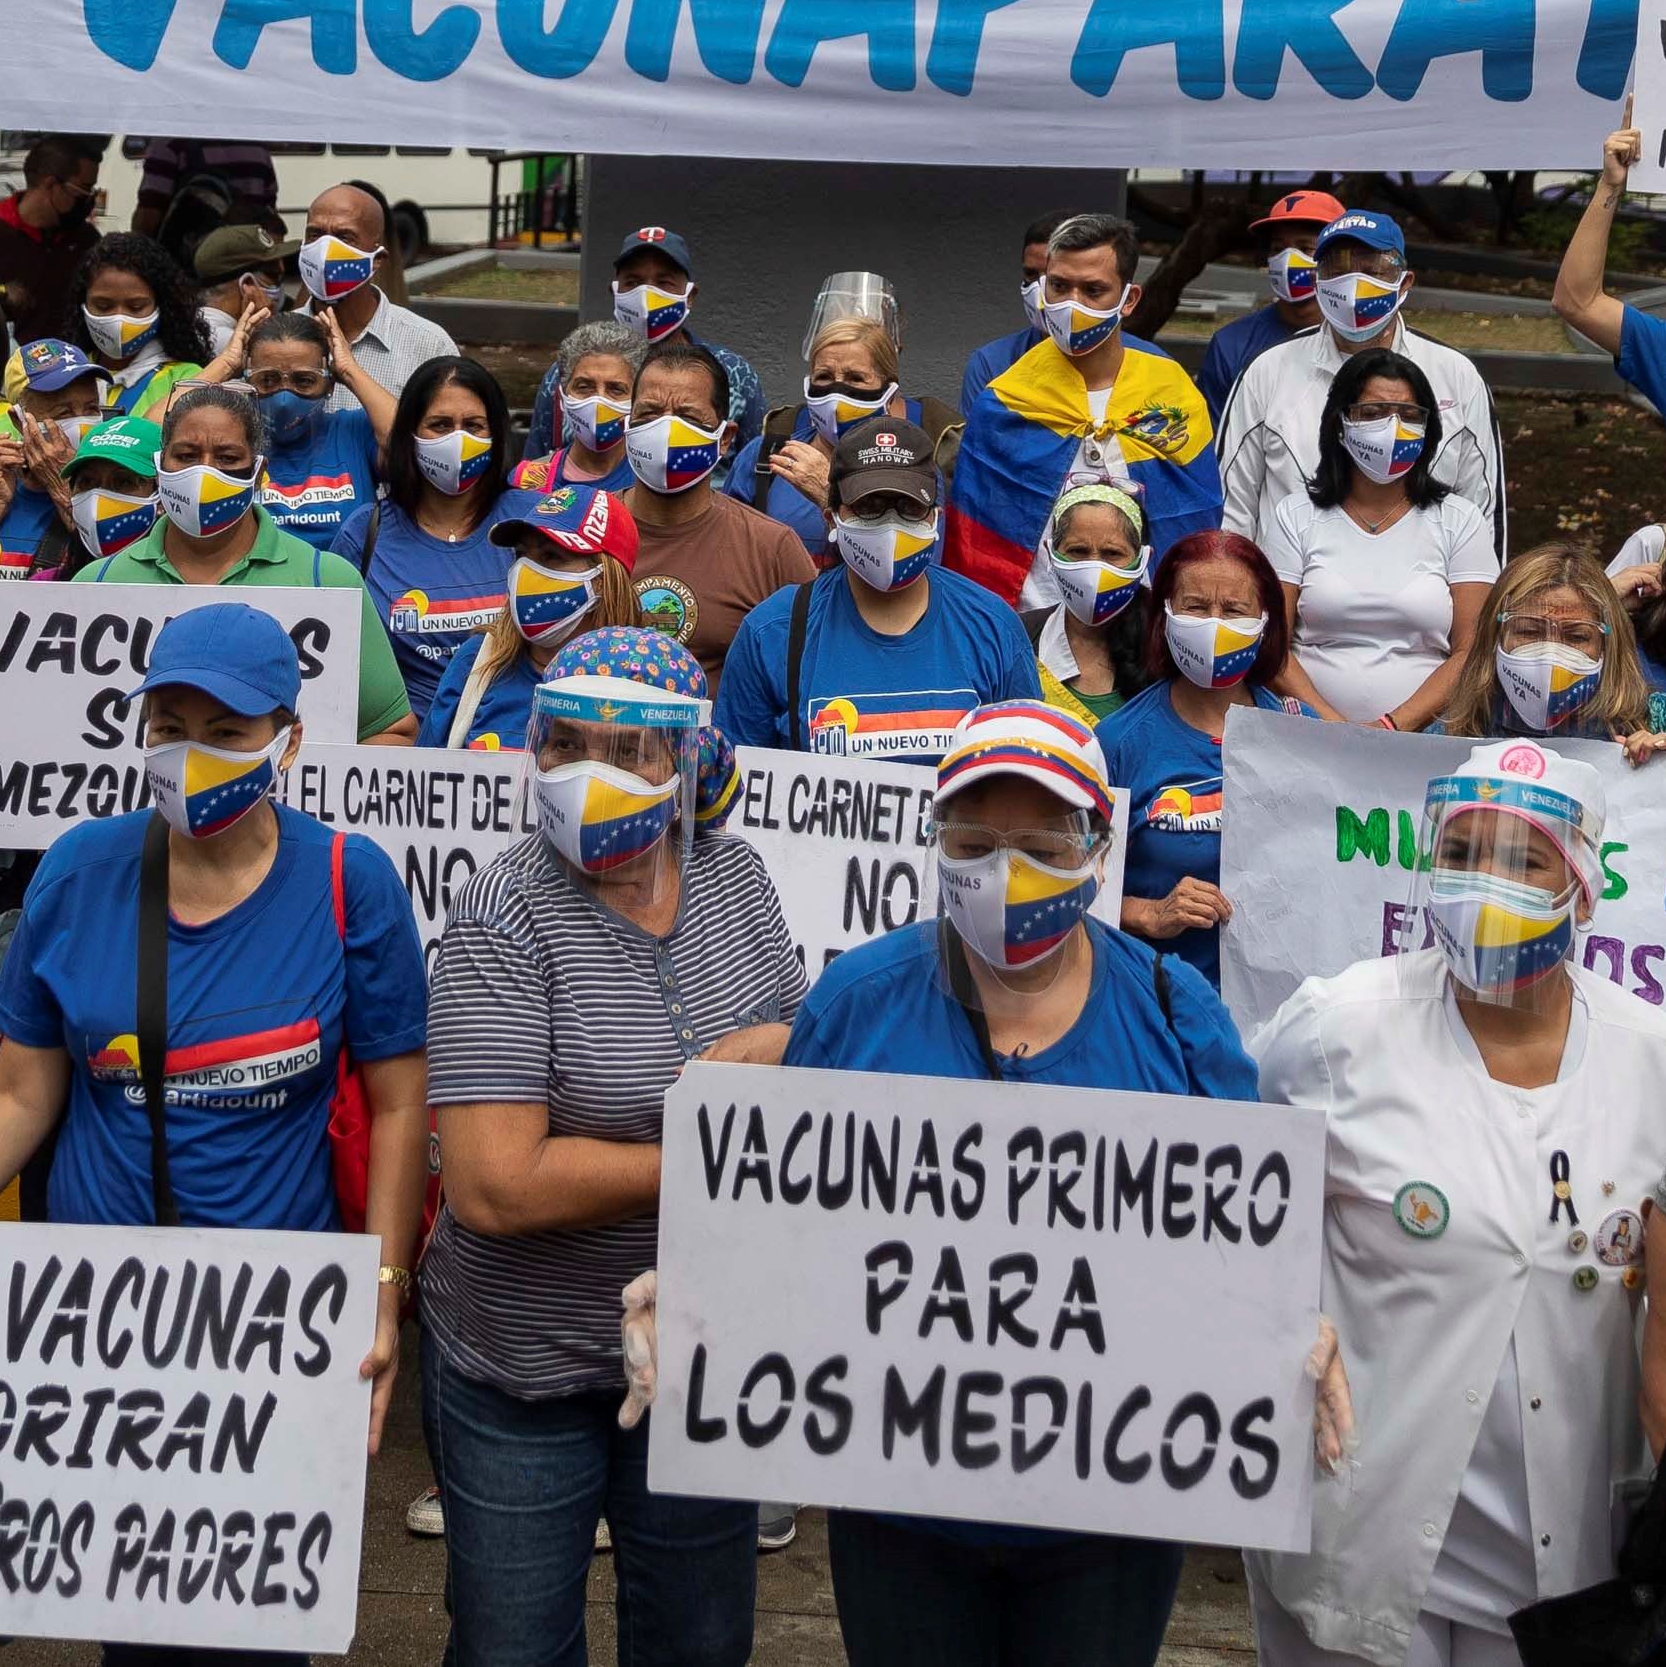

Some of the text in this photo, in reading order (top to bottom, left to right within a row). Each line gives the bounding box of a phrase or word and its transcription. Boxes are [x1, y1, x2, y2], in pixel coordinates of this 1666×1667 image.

[1328, 298, 1339, 310] YA
[88, 433, 140, 447] COPEI
[1348, 435, 1384, 456] VACUNAS
[857, 445, 914, 459] SWISS MILITARY
[862, 456, 910, 466] HANOWA
[1357, 449, 1372, 462] YA
[422, 465, 438, 479] YA
[314, 487, 355, 502] TIEMPO
[168, 499, 183, 516] YA
[842, 532, 882, 568] VACUNAS
[851, 551, 866, 569] YA
[421, 615, 476, 631] UN NUEVO
[1177, 653, 1191, 670] YA
[1501, 663, 1542, 699] VACUNAS
[1512, 683, 1528, 702] YA
[640, 708, 692, 722] VENEZUELA
[851, 736, 923, 752] UN NUEVO
[300, 764, 512, 833] EL CARNET DE
[742, 769, 780, 831] EL
[787, 773, 914, 845] CARNET
[843, 855, 920, 936] NO
[180, 1048, 319, 1087] NUEVO TIEMPO
[124, 1085, 288, 1109] @artidount
[696, 1101, 987, 1222] VACUNAS
[1005, 1124, 1292, 1247] PRIMERO
[863, 1238, 1106, 1356] PARA
[6, 1254, 348, 1378] VACUNAS
[684, 1340, 1282, 1501] LOS MEDICOS
[106, 1500, 333, 1611] PADRES
